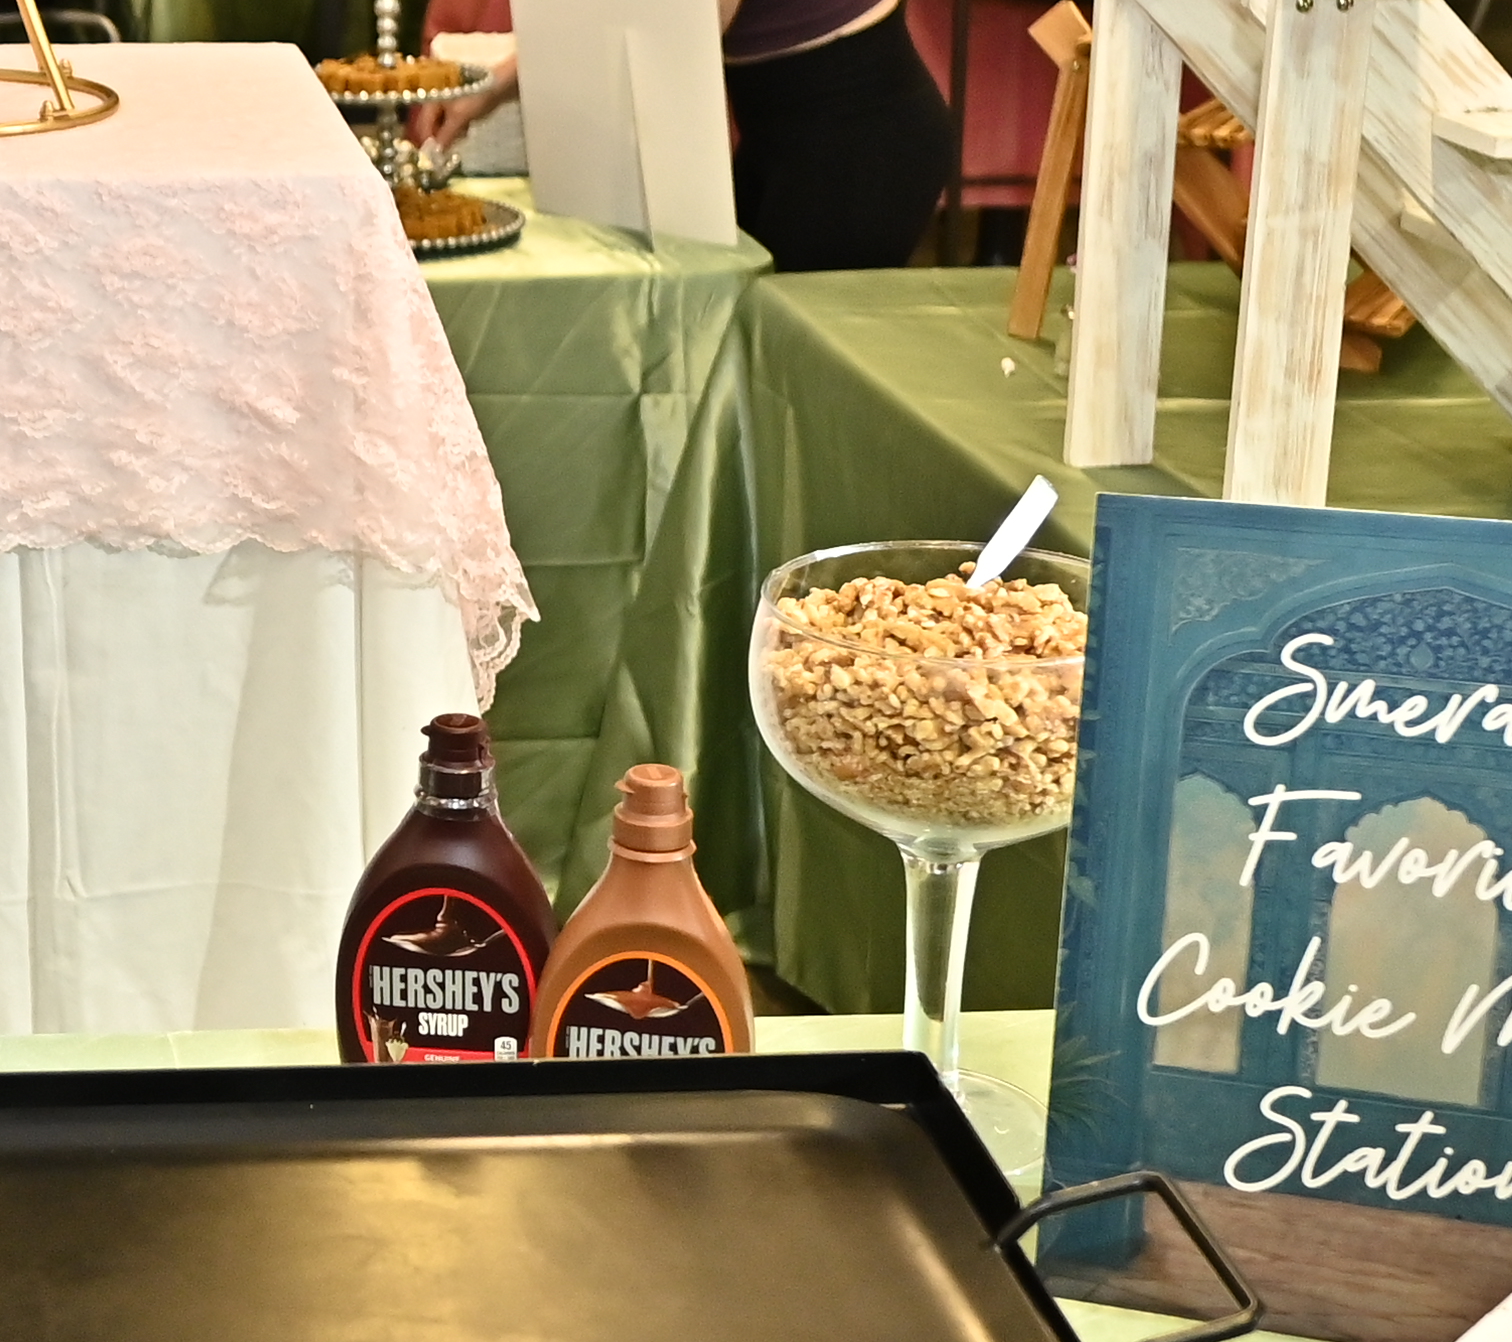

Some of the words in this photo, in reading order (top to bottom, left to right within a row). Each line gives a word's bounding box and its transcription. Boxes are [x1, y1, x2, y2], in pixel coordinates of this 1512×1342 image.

[373, 965, 520, 1014] HERSHEY'S
[1137, 932, 1416, 1035] Cookie
[417, 1011, 469, 1037] SYRUP
[500, 1040, 512, 1051] 45
